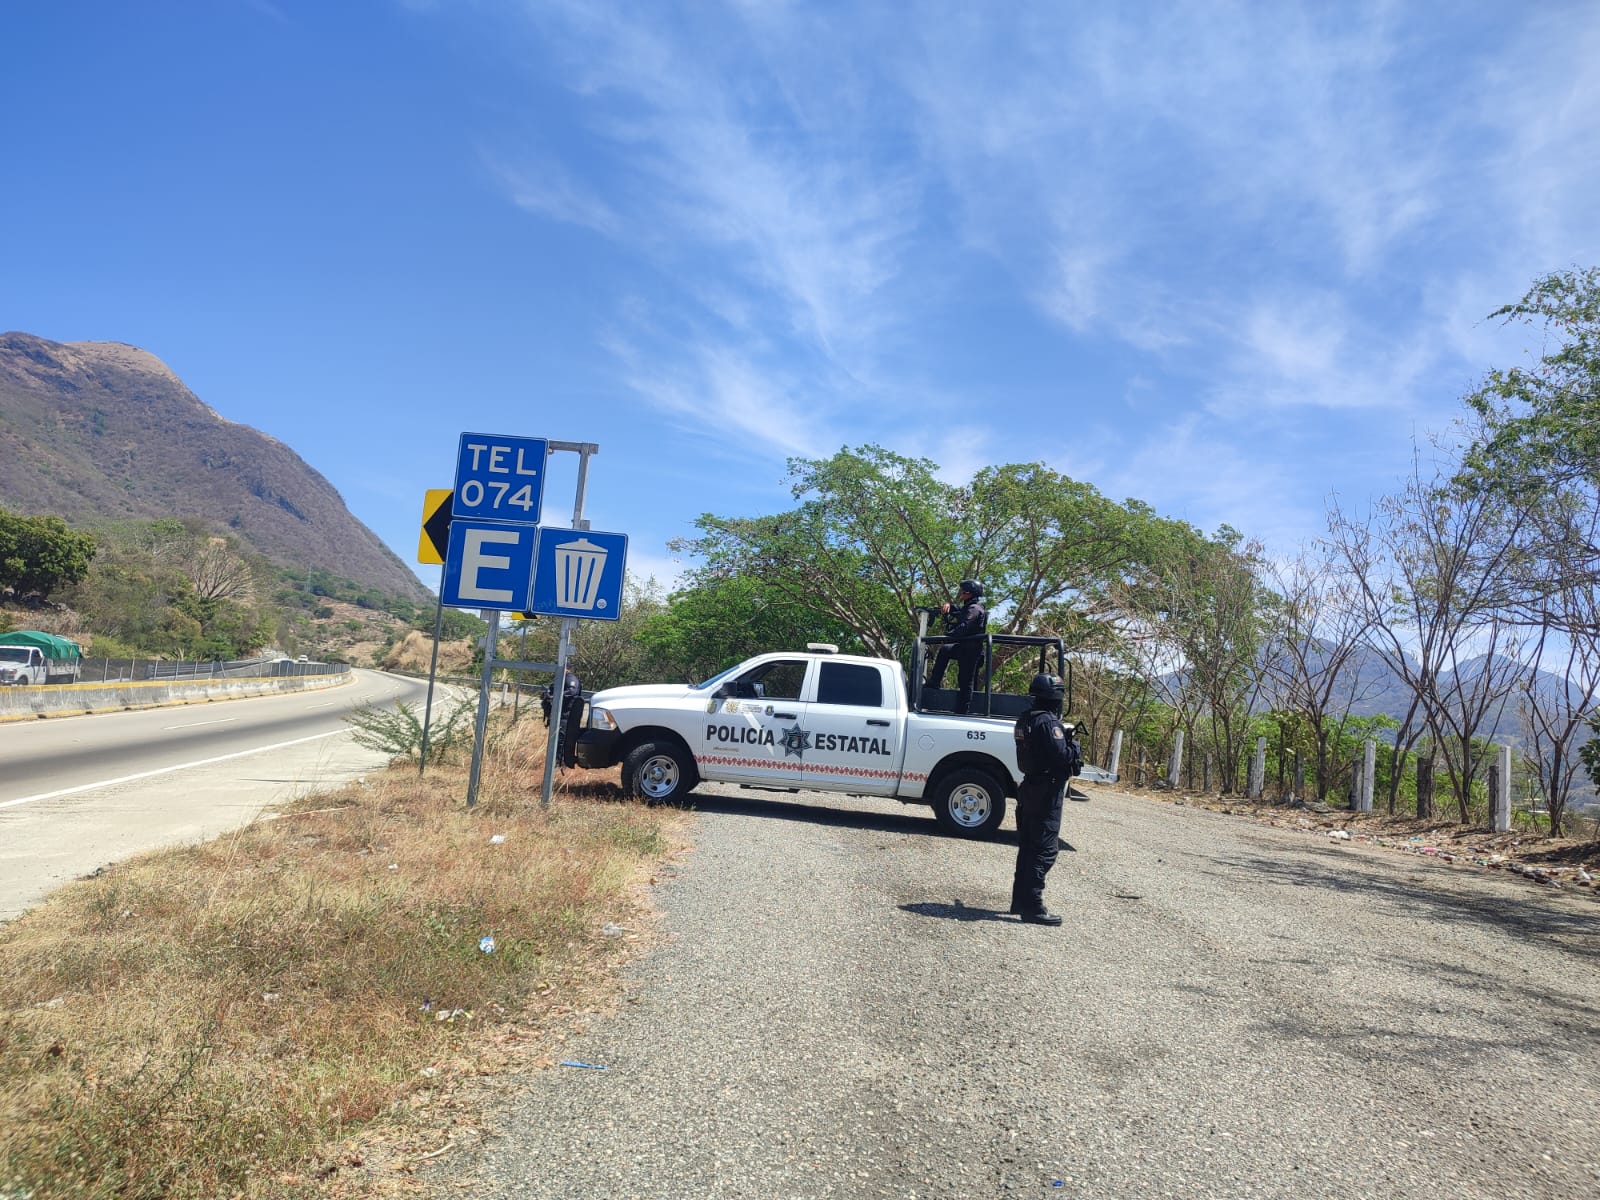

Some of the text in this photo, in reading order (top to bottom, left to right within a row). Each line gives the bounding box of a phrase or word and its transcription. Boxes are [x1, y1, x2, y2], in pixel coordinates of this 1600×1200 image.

[467, 443, 537, 476] TEL
[461, 479, 534, 512] 074
[458, 528, 520, 602] E
[706, 724, 892, 756] POLICÍA ESTATAL
[966, 730, 986, 741] 635
